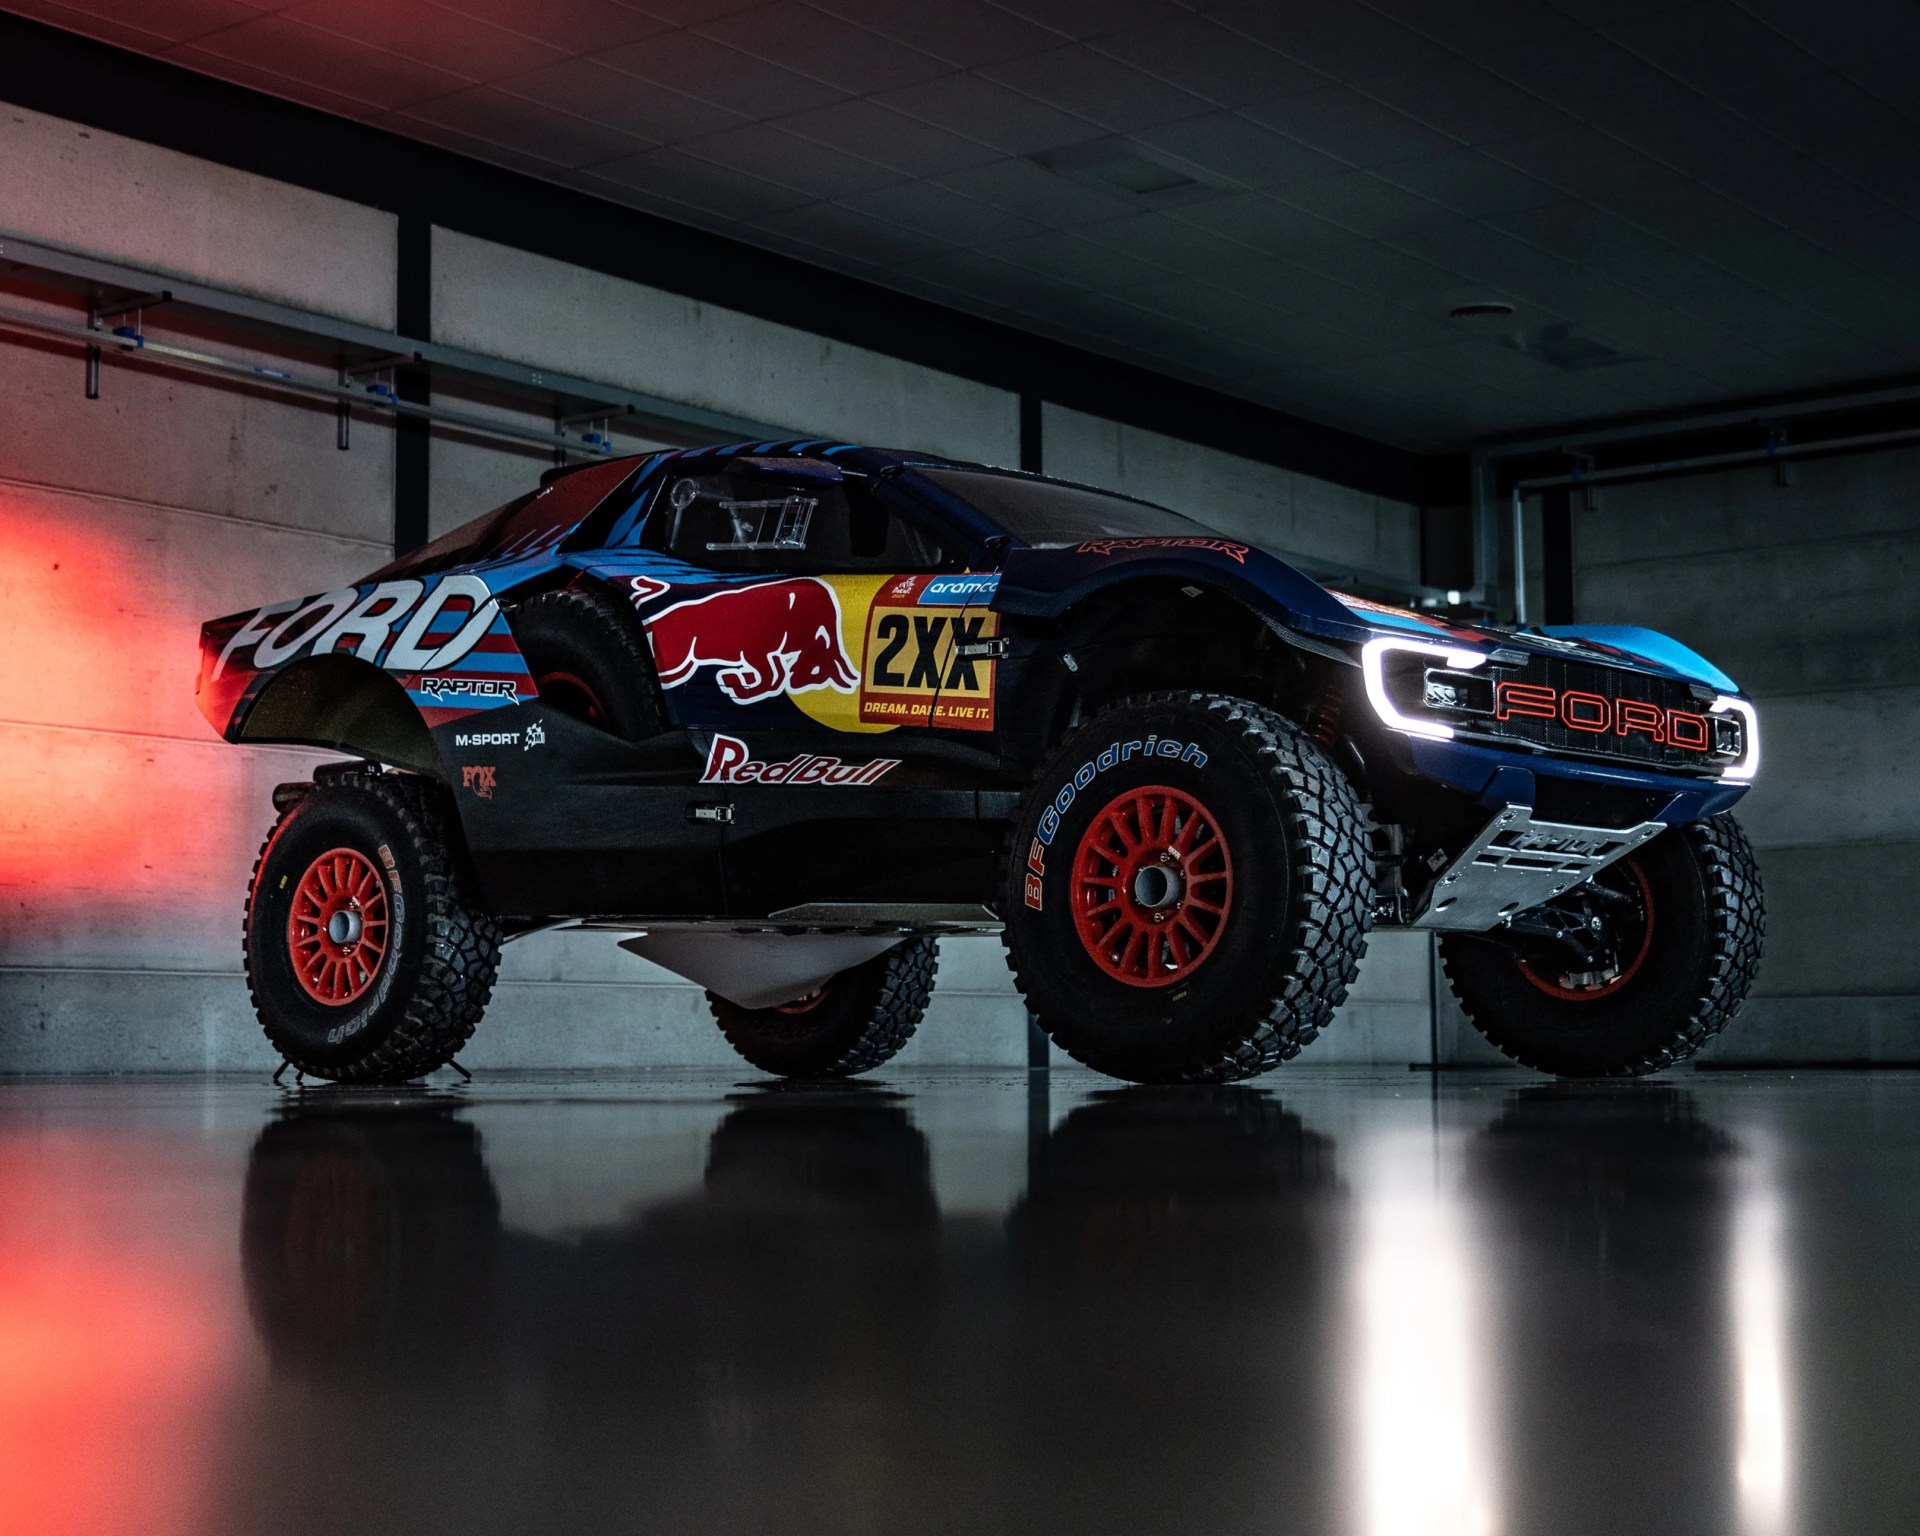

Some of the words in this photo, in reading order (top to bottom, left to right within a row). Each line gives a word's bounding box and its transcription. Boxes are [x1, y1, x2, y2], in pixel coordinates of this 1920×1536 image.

[210, 575, 500, 682] FORD
[873, 614, 986, 690] 2XX
[421, 677, 520, 706] RAPTOR
[864, 702, 908, 714] DREAM.
[948, 706, 974, 718] LIVE
[976, 708, 990, 719] IT.
[1496, 683, 1708, 751] FORD
[462, 765, 497, 800] FOX
